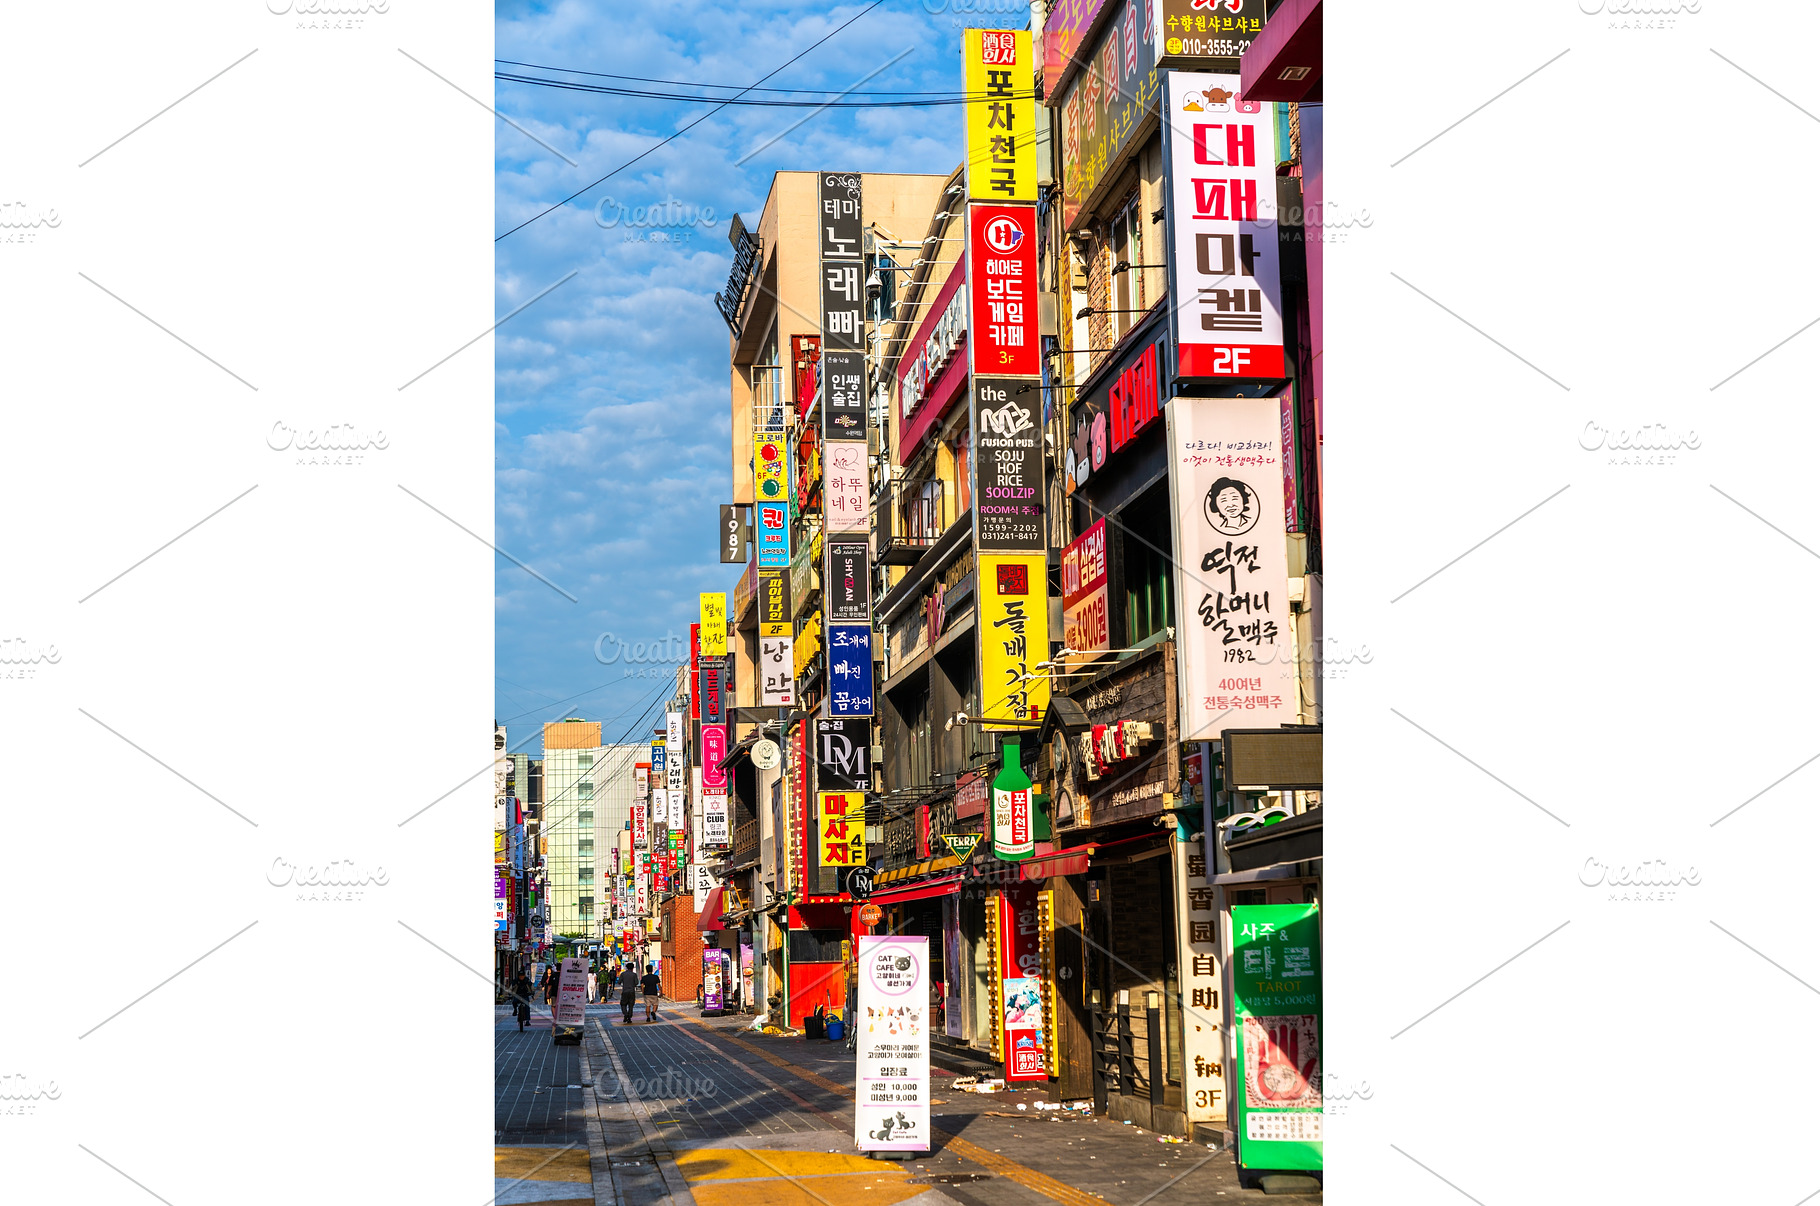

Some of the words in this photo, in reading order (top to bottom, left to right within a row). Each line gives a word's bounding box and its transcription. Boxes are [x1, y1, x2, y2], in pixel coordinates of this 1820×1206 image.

[1167, 14, 1262, 33] 수향원샤브샤브
[983, 32, 1015, 49] 酒食
[1182, 38, 1255, 56] 010-3555-22
[983, 49, 1016, 64] 회사
[987, 70, 1016, 197] 포차천국
[824, 199, 861, 220] 테마
[986, 259, 1022, 275] 히어로
[824, 226, 864, 344] 노래빠
[987, 278, 1023, 300] 보드
[988, 302, 1024, 324] 게임
[989, 325, 1024, 346] 카페
[999, 351, 1014, 364] 3F
[1213, 347, 1251, 374] 2F
[831, 374, 860, 390] 인쌩
[831, 391, 861, 407] 술집
[980, 386, 1006, 401] the
[756, 434, 784, 443] 크로바
[1015, 438, 1034, 448] PUB
[1185, 440, 1222, 450] 다르다!
[1226, 440, 1272, 450] 비교하라!
[995, 450, 1025, 462] SOJU
[1183, 455, 1212, 467] 이것이
[997, 463, 1022, 474] HOF
[831, 476, 863, 493] 하뚜
[997, 475, 1023, 486] RICE
[986, 487, 1035, 499] SOOLZIP
[831, 495, 863, 512] 네일
[980, 505, 1018, 516] ROOM식
[762, 507, 784, 529] 퀸
[857, 517, 868, 525] 2F
[728, 506, 739, 560] 1987
[981, 532, 1038, 540] 031)241-8417
[983, 524, 1037, 532] 1599-2202
[1081, 526, 1105, 588] 삼겹살
[1201, 541, 1262, 595] 역전
[1076, 594, 1107, 660] 3,900원
[1198, 591, 1270, 646] 할머니
[770, 625, 783, 634] 2F
[1238, 619, 1278, 646] 맥주
[1223, 649, 1256, 664] 1982
[763, 641, 792, 694] 낭만
[833, 660, 861, 680] 빠진
[1218, 677, 1262, 691] 40여년
[833, 692, 871, 711] 꼼장어
[1203, 696, 1283, 710] 전통숙성맥주
[653, 746, 664, 771] 고시원
[821, 733, 867, 776] DM
[670, 758, 681, 789] 노래방
[1014, 792, 1027, 843] 포차천국
[824, 795, 849, 864] 마사지
[947, 836, 978, 848] TERRA
[855, 874, 873, 892] DM
[1240, 923, 1276, 941] 사주
[1279, 930, 1289, 941] &
[1256, 981, 1302, 992] TAROT
[1274, 994, 1317, 1006] 5,000원
[880, 1066, 908, 1077] 입장료
[870, 1083, 886, 1091] 성인
[891, 1083, 918, 1092] 10,000
[870, 1094, 894, 1102] 미성년
[895, 1094, 918, 1102] 9,000
[1195, 1090, 1222, 1108] 3F
